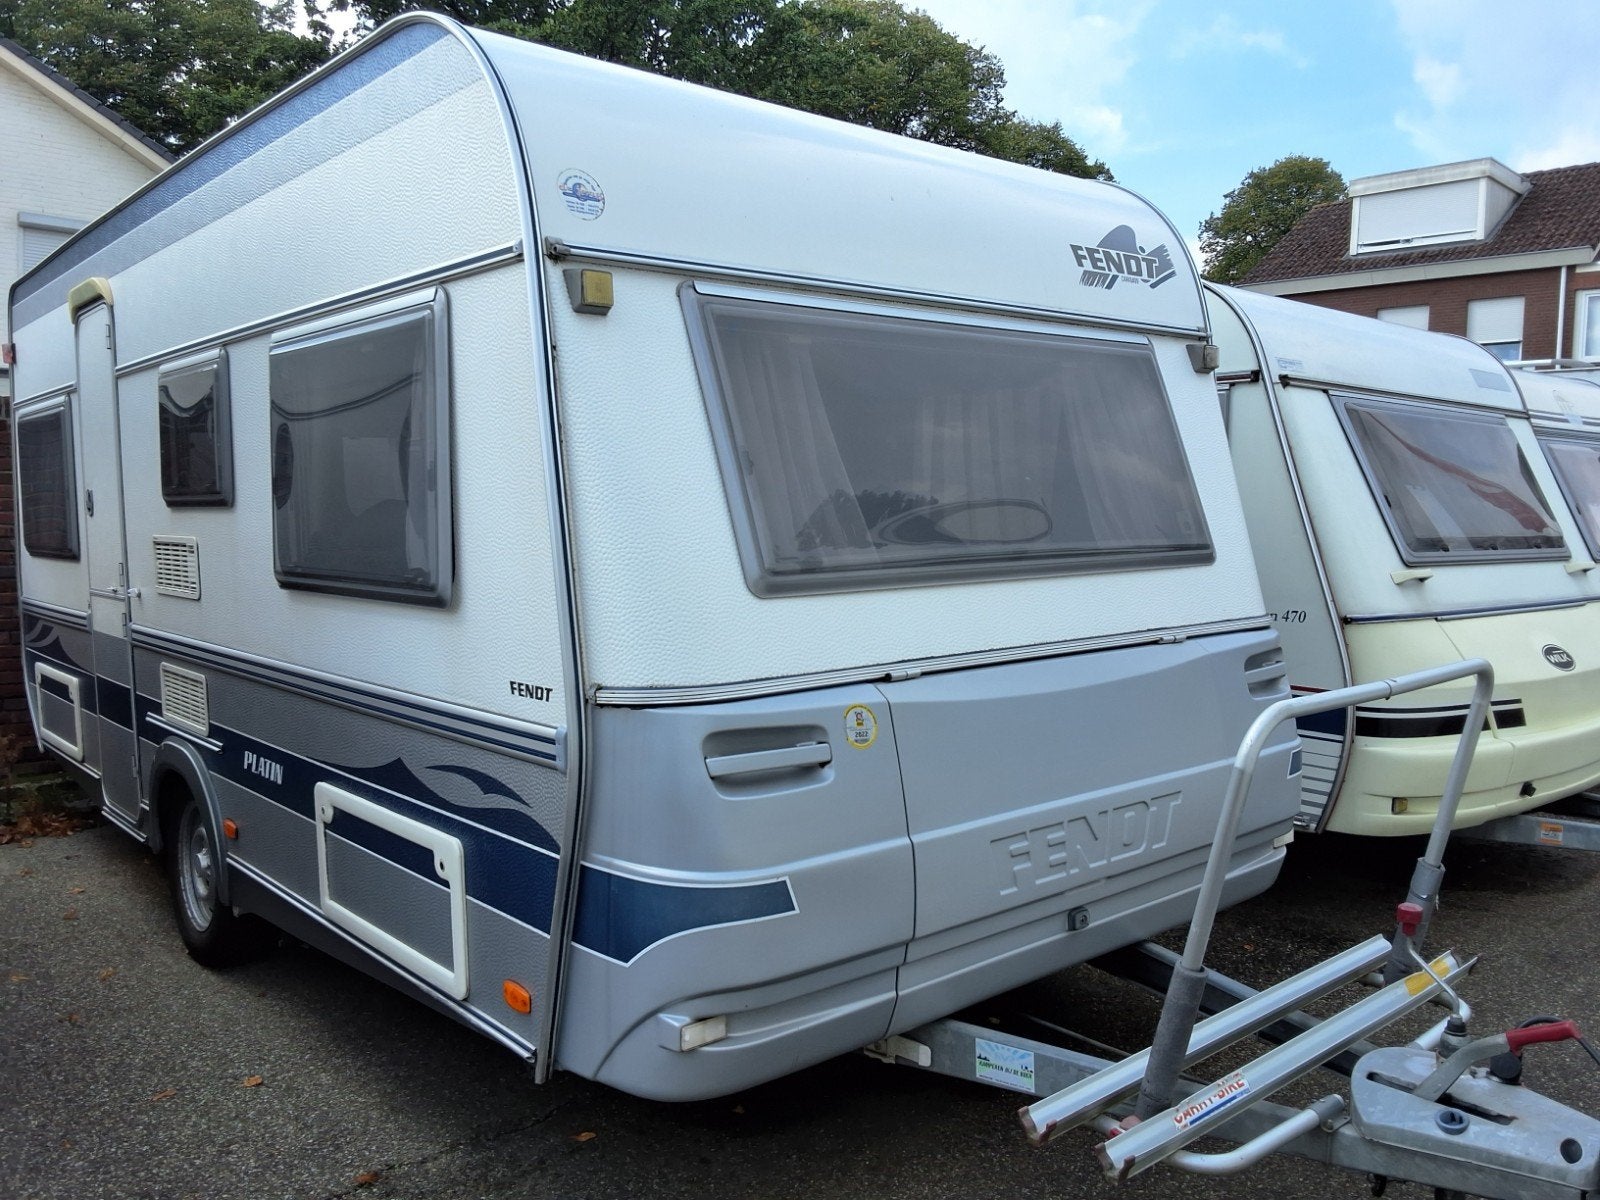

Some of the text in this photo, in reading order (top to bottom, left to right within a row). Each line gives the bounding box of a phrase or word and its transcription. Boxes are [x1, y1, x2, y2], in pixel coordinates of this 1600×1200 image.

[1069, 243, 1158, 279] FENDT
[1281, 610, 1307, 623] 470
[509, 680, 554, 703] FENDT
[243, 750, 284, 785] PLATIN
[990, 790, 1183, 896] FENDT
